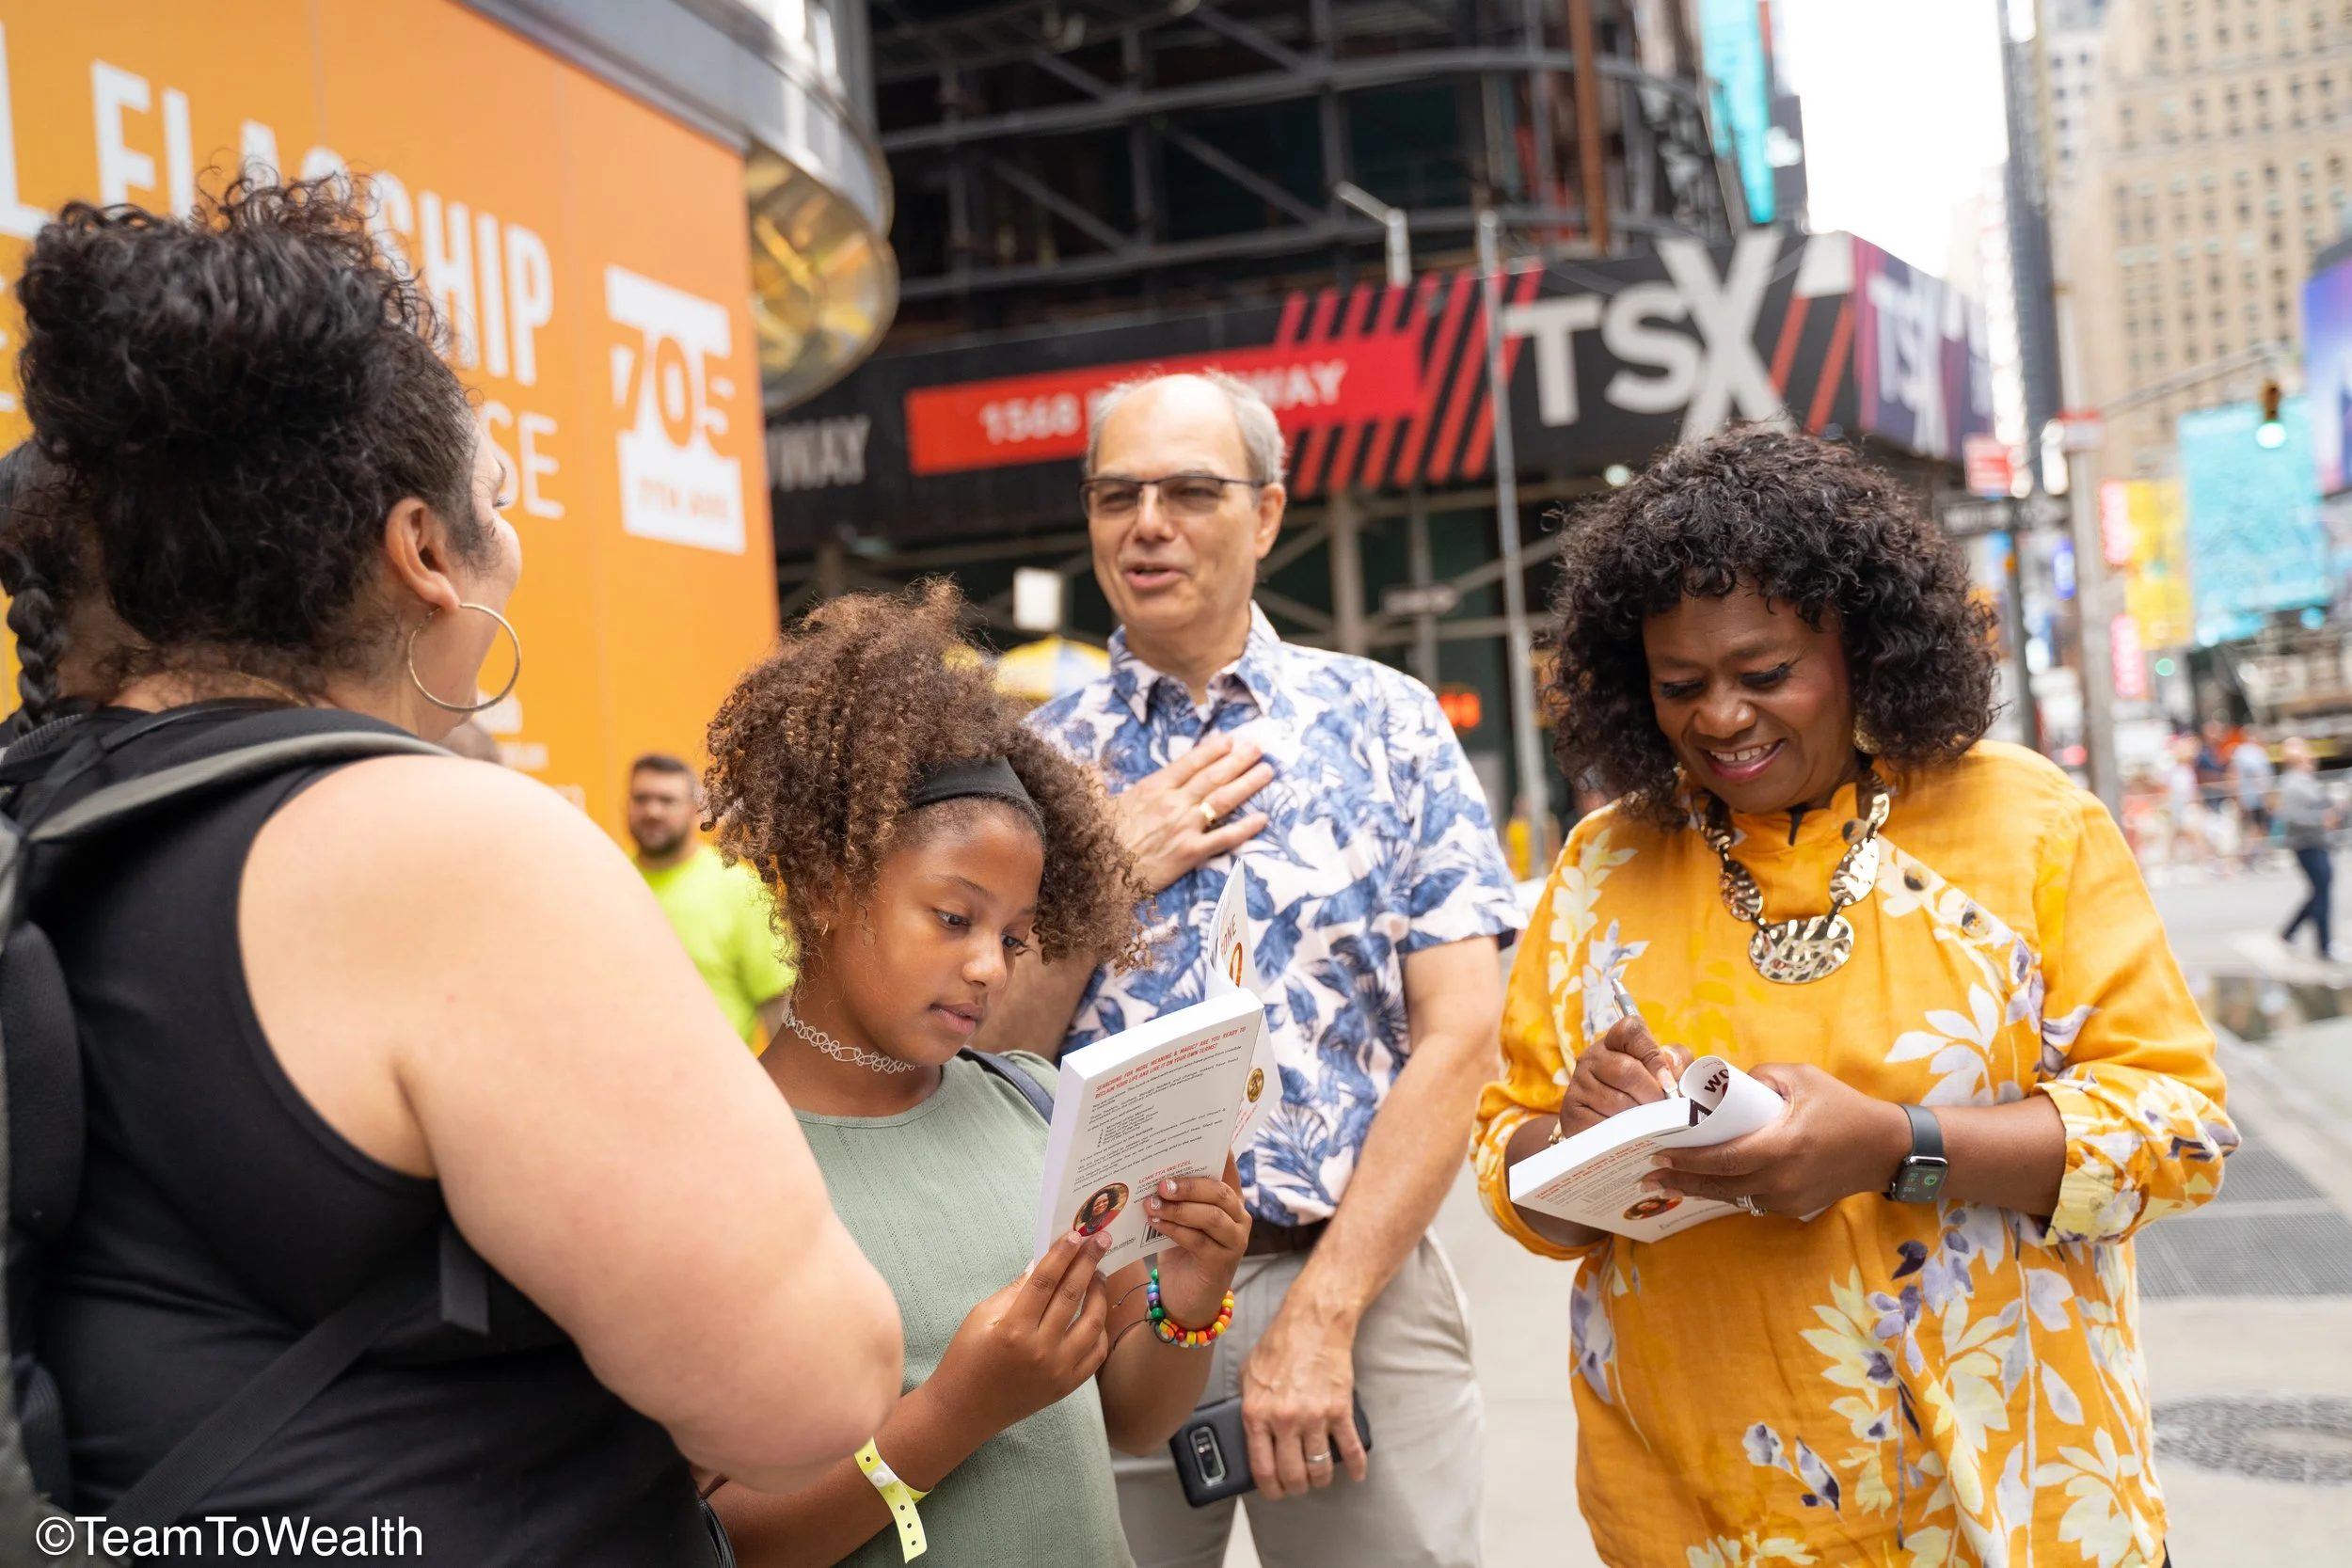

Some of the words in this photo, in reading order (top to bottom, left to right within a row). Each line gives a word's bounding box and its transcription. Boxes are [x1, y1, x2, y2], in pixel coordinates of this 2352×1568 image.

[1502, 226, 1792, 450] TSX
[978, 390, 1081, 445] 1568
[1151, 1053, 1171, 1066] MEANING
